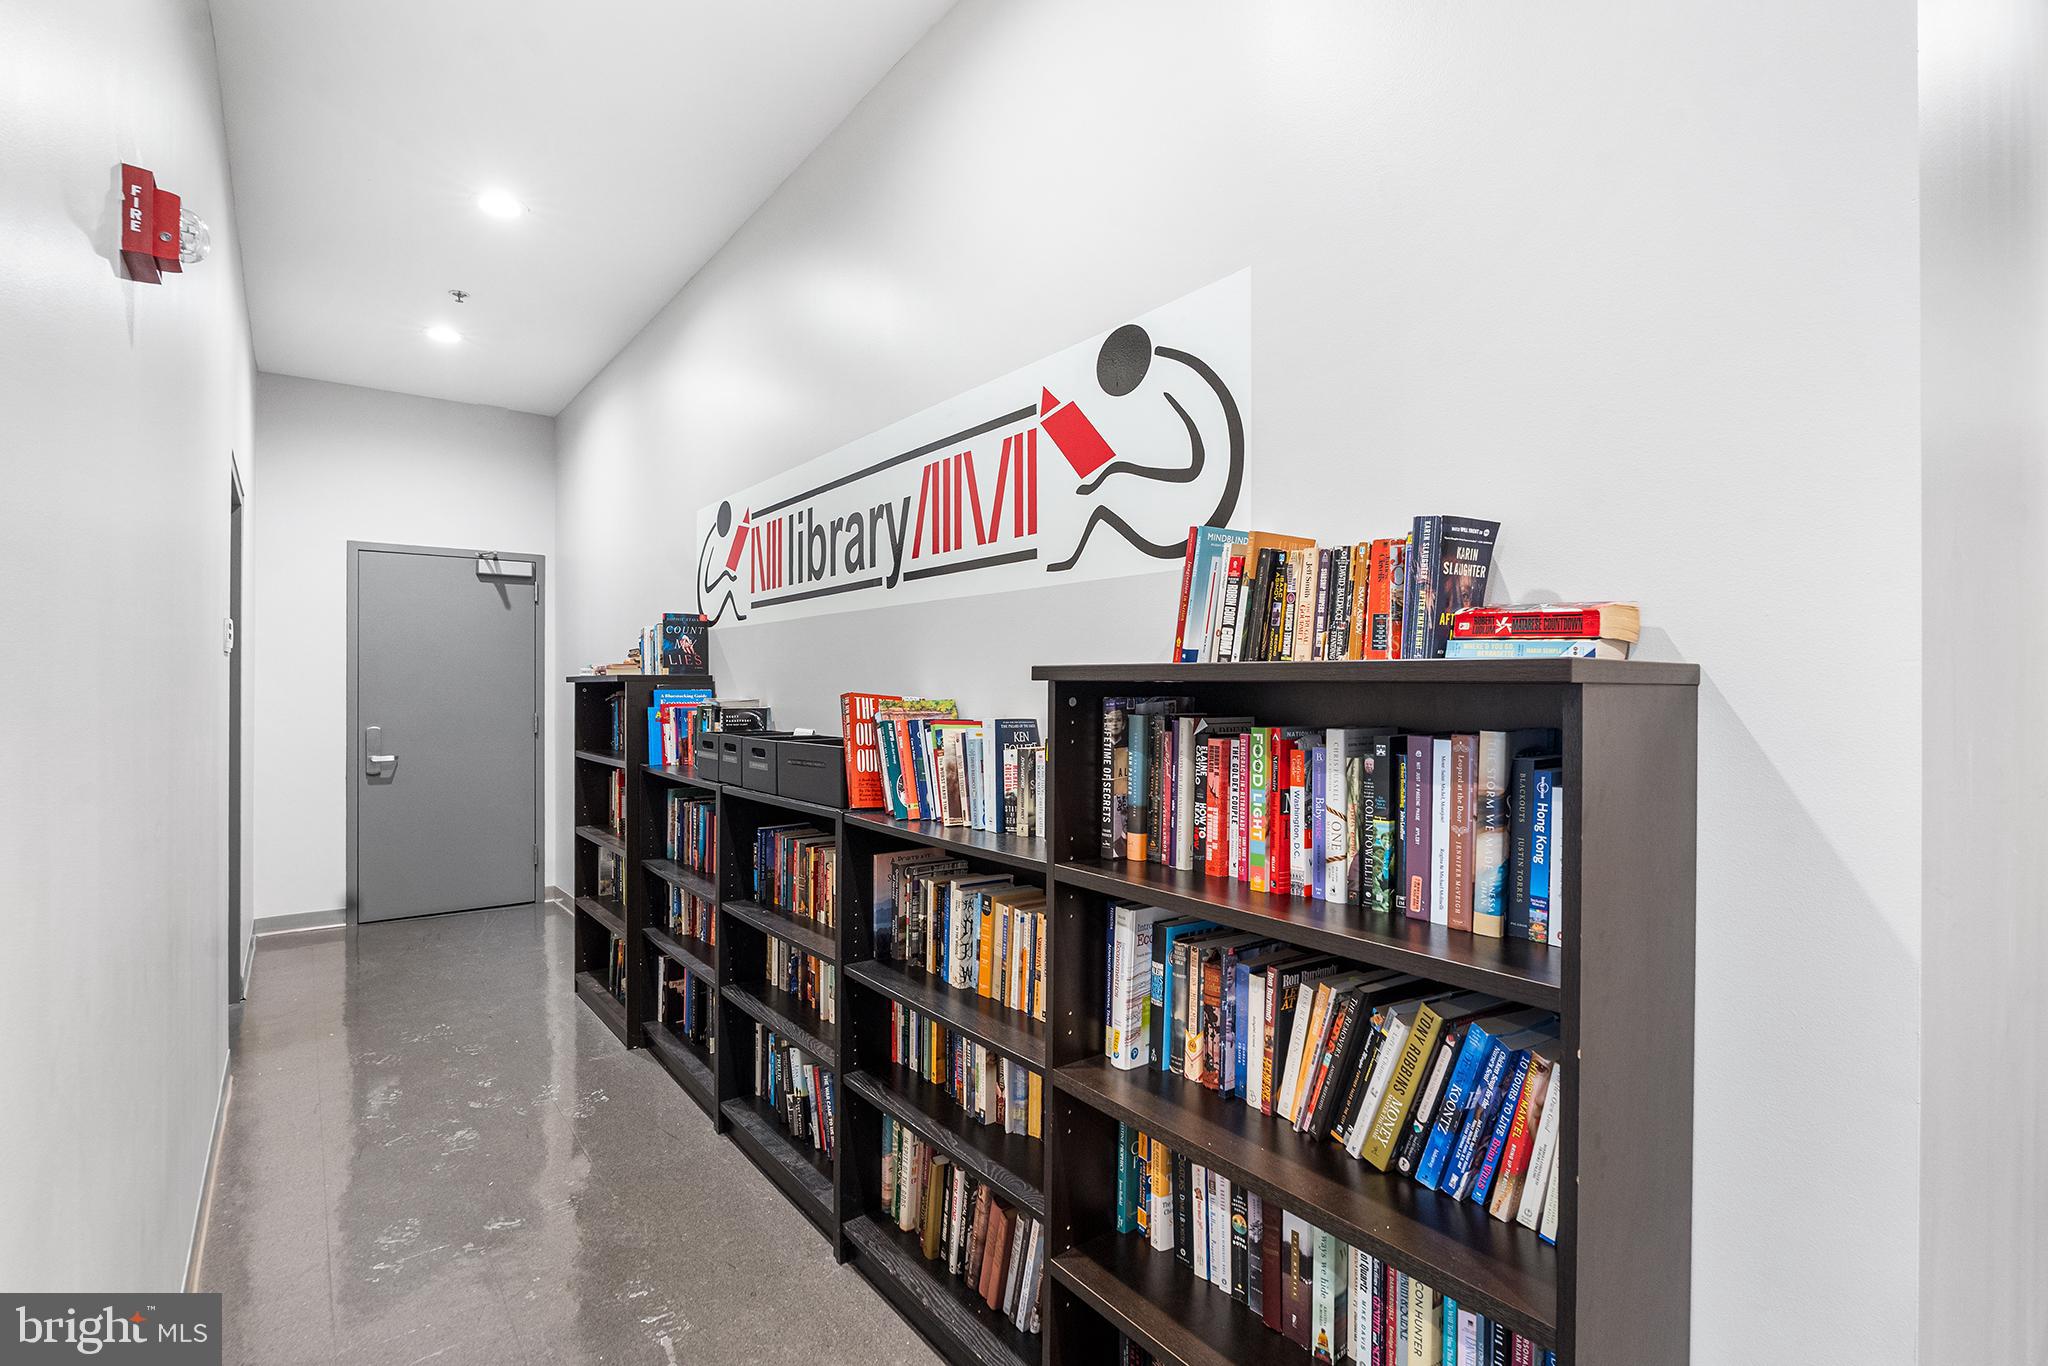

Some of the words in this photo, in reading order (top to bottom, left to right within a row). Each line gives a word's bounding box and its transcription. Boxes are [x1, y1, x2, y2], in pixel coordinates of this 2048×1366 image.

[130, 184, 142, 232] FIRE
[1207, 532, 1249, 545] MINDBLIND
[1423, 520, 1432, 540] KARIN
[788, 496, 911, 589] library
[1456, 546, 1478, 561] KARIN
[1420, 542, 1430, 580] SLAUGHTER
[1442, 562, 1486, 578] SLAUGHTER
[1226, 584, 1238, 606] ROBIN
[1304, 576, 1312, 598] Smith
[1418, 590, 1426, 610] AFTER
[1223, 606, 1236, 626] COOK
[1356, 608, 1364, 634] ASIMOV
[1417, 612, 1425, 629] THAT
[1512, 617, 1542, 630] MATARESE
[1544, 617, 1583, 630] COUNTDOWN
[666, 626, 705, 634] COUNT
[1416, 630, 1424, 650] NIGHT
[1219, 628, 1234, 656] COMA
[669, 654, 702, 665] LIES
[854, 696, 874, 720] THE
[1013, 731, 1029, 742] KEN
[1103, 723, 1112, 764] LIFETIME
[1252, 733, 1263, 787] FOOD
[1487, 740, 1495, 762] THE
[1103, 768, 1111, 780] OF
[1240, 779, 1246, 787] IN
[1486, 768, 1495, 809] STORM
[1102, 782, 1111, 823] SECRETS
[1292, 790, 1302, 841] Washington,
[1314, 798, 1324, 840] Babywise
[1364, 799, 1374, 832] COLIN
[1485, 814, 1494, 831] WE
[1535, 802, 1548, 832] Hong
[1199, 826, 1206, 838] TO
[1331, 821, 1341, 851] ONE
[1364, 834, 1374, 877] POWELL
[1485, 838, 1494, 870] MADE
[1533, 835, 1548, 864] Kong
[1283, 974, 1299, 988] Ron
[1265, 987, 1274, 1023] Burgundy
[1348, 998, 1358, 1014] THE
[1334, 1016, 1352, 1058] REMOVERS
[1414, 1012, 1434, 1045] TONY
[1486, 1046, 1500, 1065] Nurse's
[1491, 1051, 1507, 1078] Chicken
[1520, 1056, 1530, 1068] 10
[1392, 1044, 1421, 1096] ROBBINS
[1483, 1067, 1494, 1082] Soul
[1523, 1062, 1538, 1097] HILARY
[1484, 1089, 1495, 1098] for
[1487, 1078, 1499, 1090] Soup
[1508, 1070, 1527, 1100] HOURS
[1437, 1084, 1463, 1135] KOONTZ
[1481, 1098, 1492, 1110] the
[1503, 1103, 1514, 1115] TO
[1376, 1097, 1403, 1147] MONEY
[1496, 1116, 1509, 1136] LIVE
[1511, 1100, 1530, 1139] MANTEL
[1544, 1114, 1555, 1132] Good
[1486, 1138, 1501, 1161] Brian
[1477, 1165, 1492, 1189] WILLS
[1319, 1236, 1328, 1257] ways
[1321, 1262, 1327, 1275] we
[1361, 1254, 1369, 1263] of
[1320, 1277, 1329, 1299] hide
[1359, 1264, 1369, 1293] Quartz
[1415, 1281, 1424, 1308] CON
[1414, 1310, 1423, 1357] HUNTER
